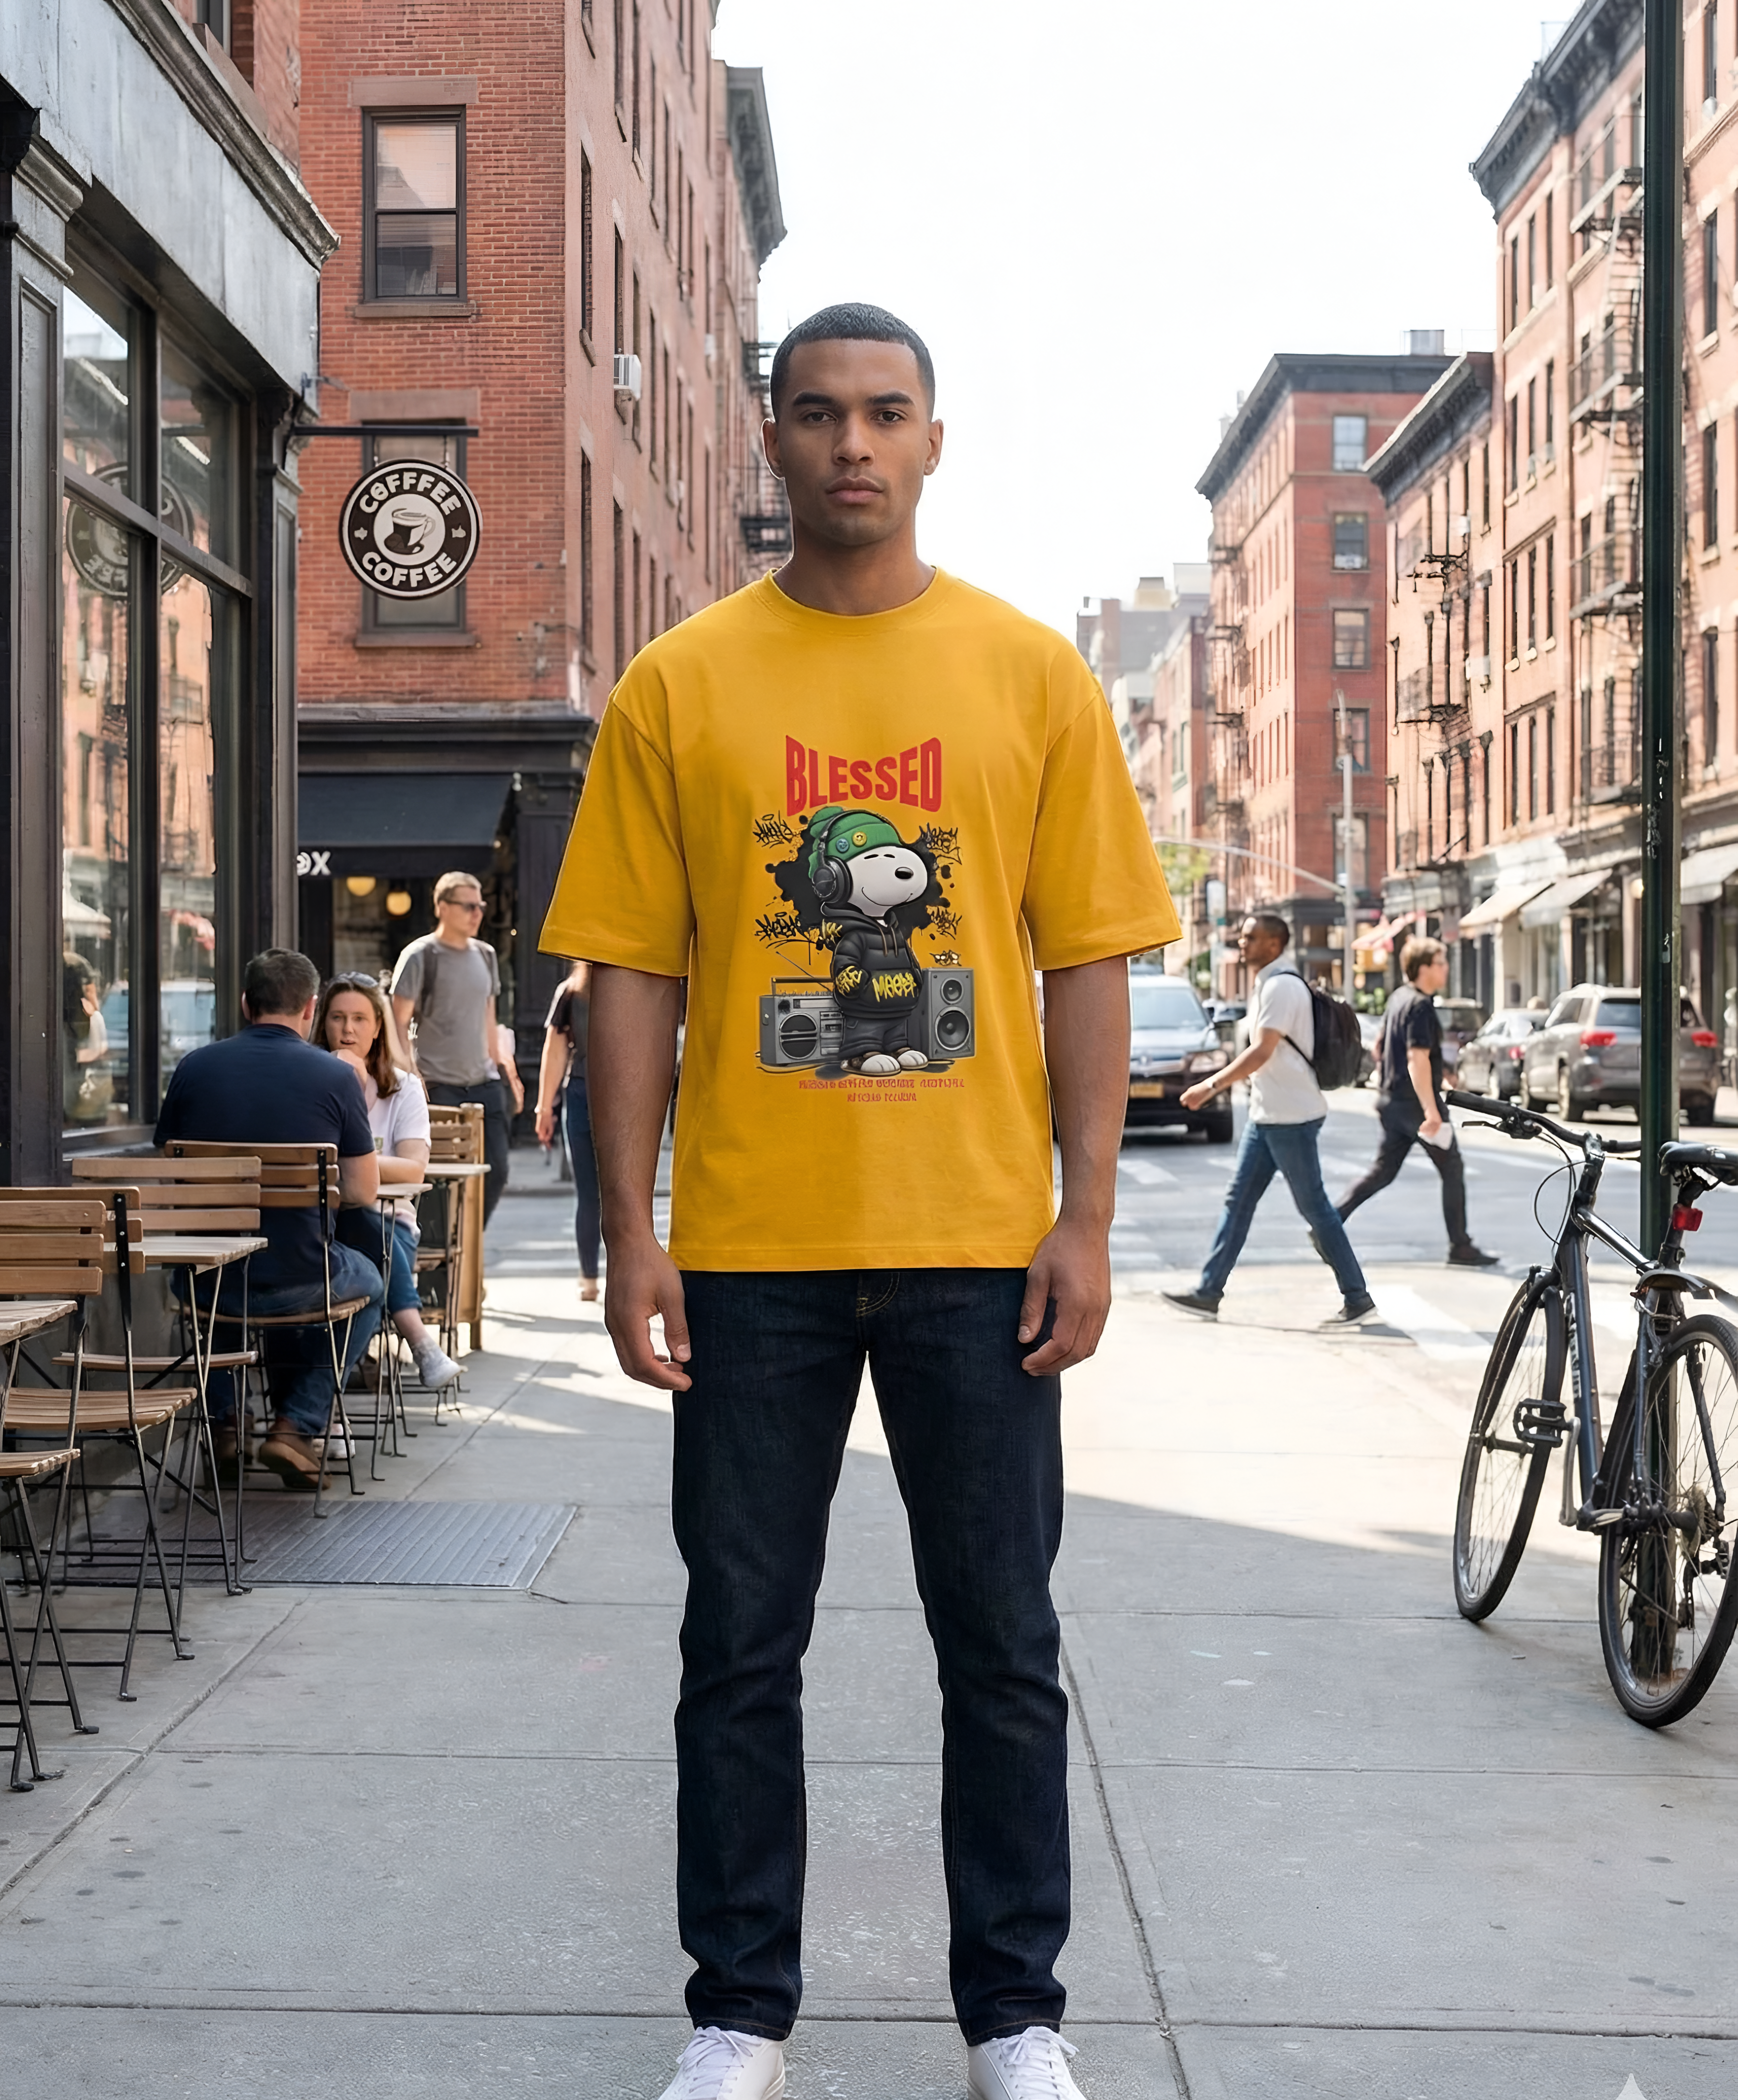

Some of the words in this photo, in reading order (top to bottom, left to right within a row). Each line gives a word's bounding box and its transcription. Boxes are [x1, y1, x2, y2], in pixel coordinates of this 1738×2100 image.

[359, 472, 462, 516] COFFFEE
[362, 551, 457, 588] COFFEE
[785, 735, 942, 817] BLESSED
